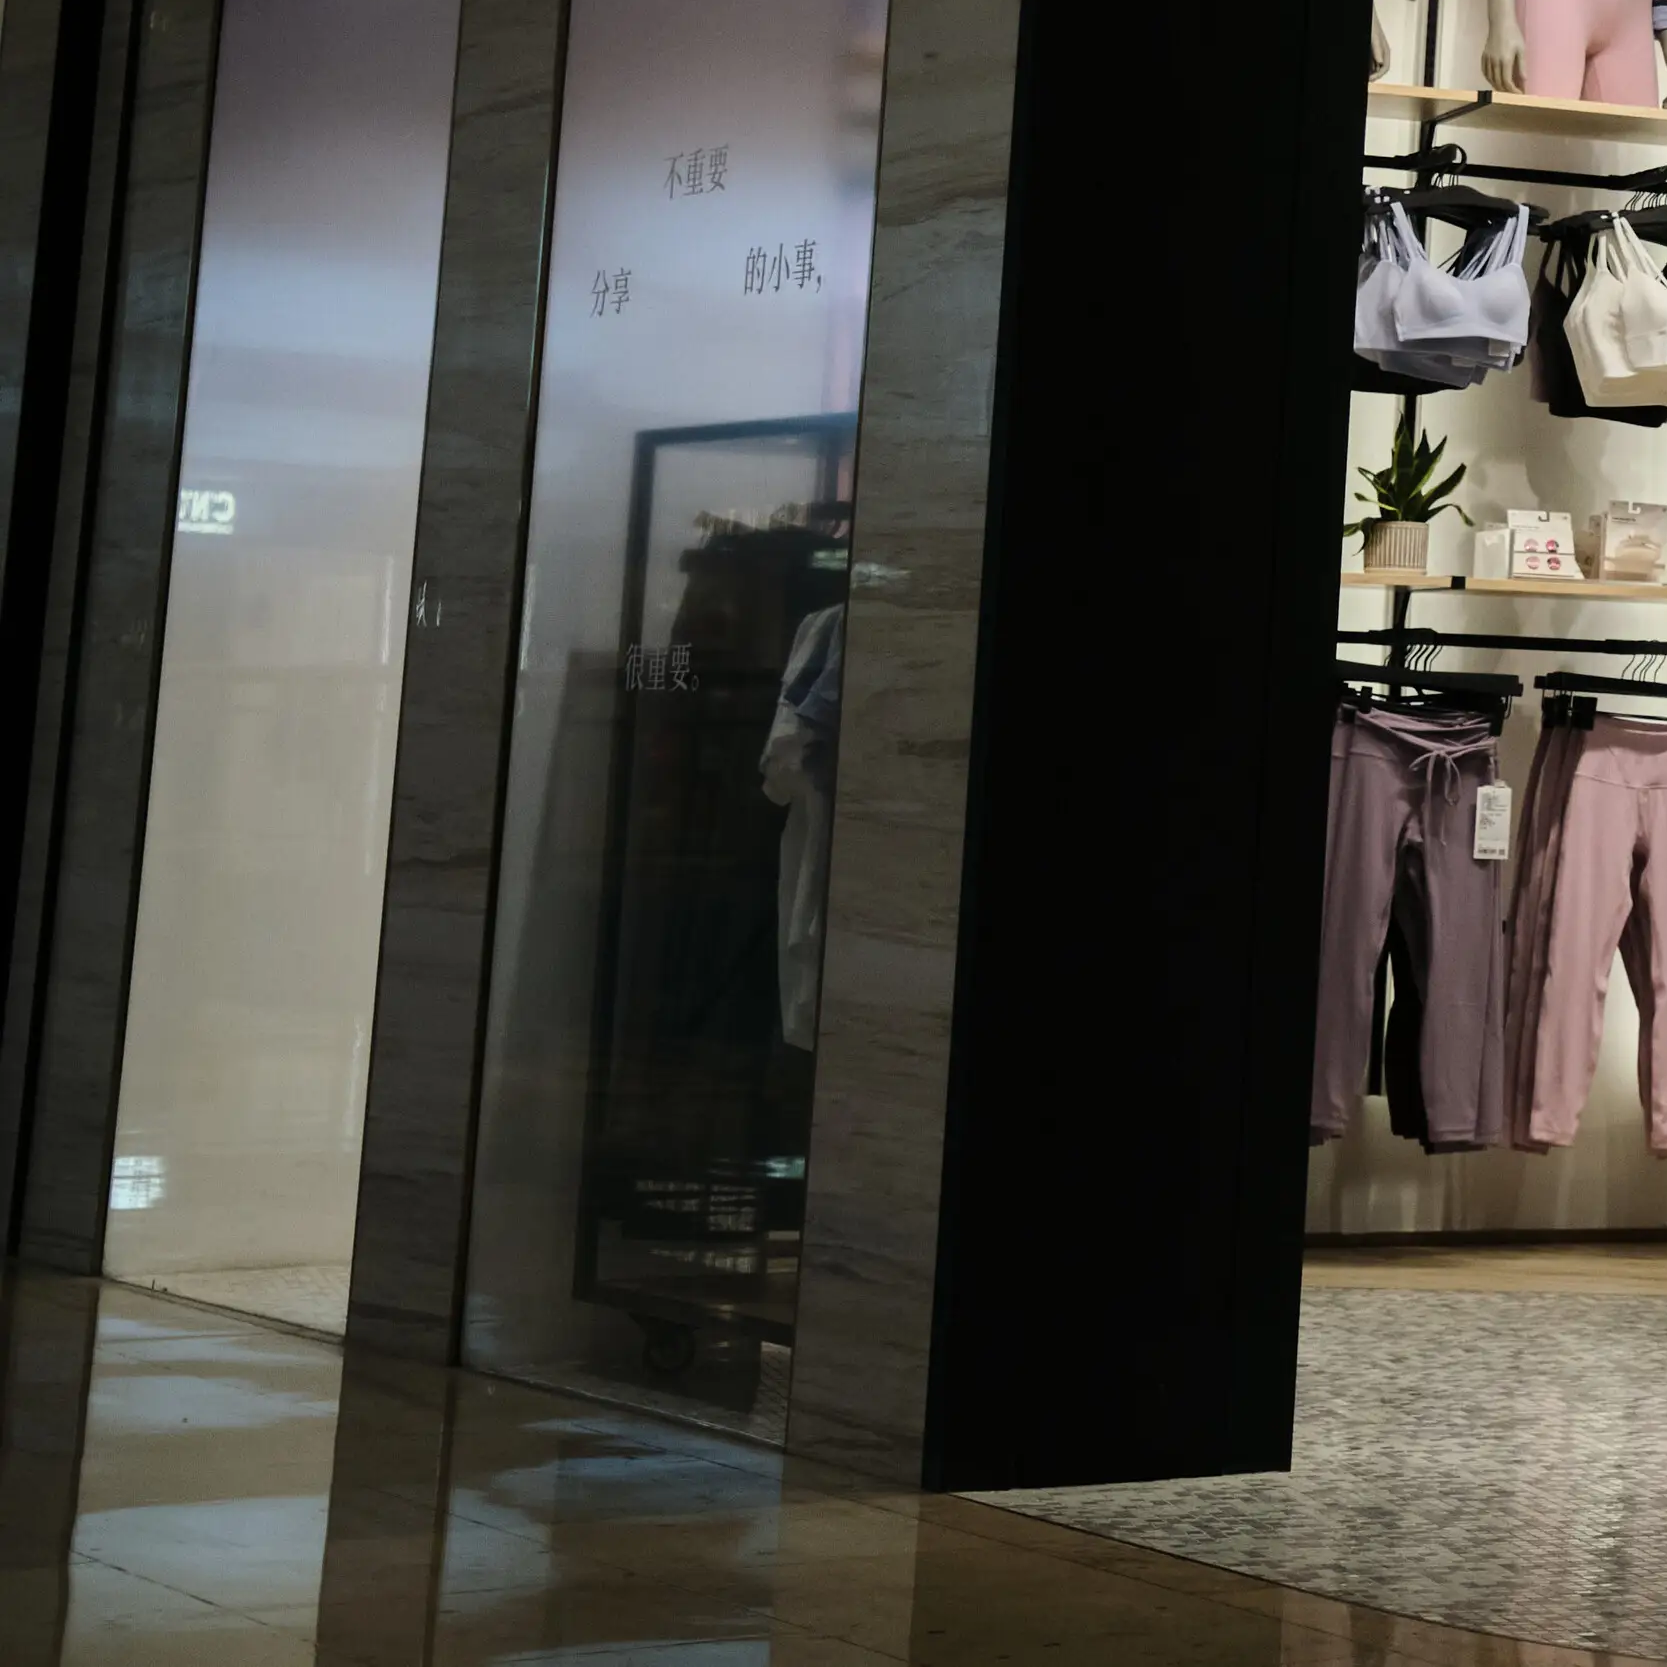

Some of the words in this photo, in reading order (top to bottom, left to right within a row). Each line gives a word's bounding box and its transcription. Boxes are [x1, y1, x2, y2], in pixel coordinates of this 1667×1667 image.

[663, 143, 730, 201] 不重要
[589, 267, 632, 319] 分享
